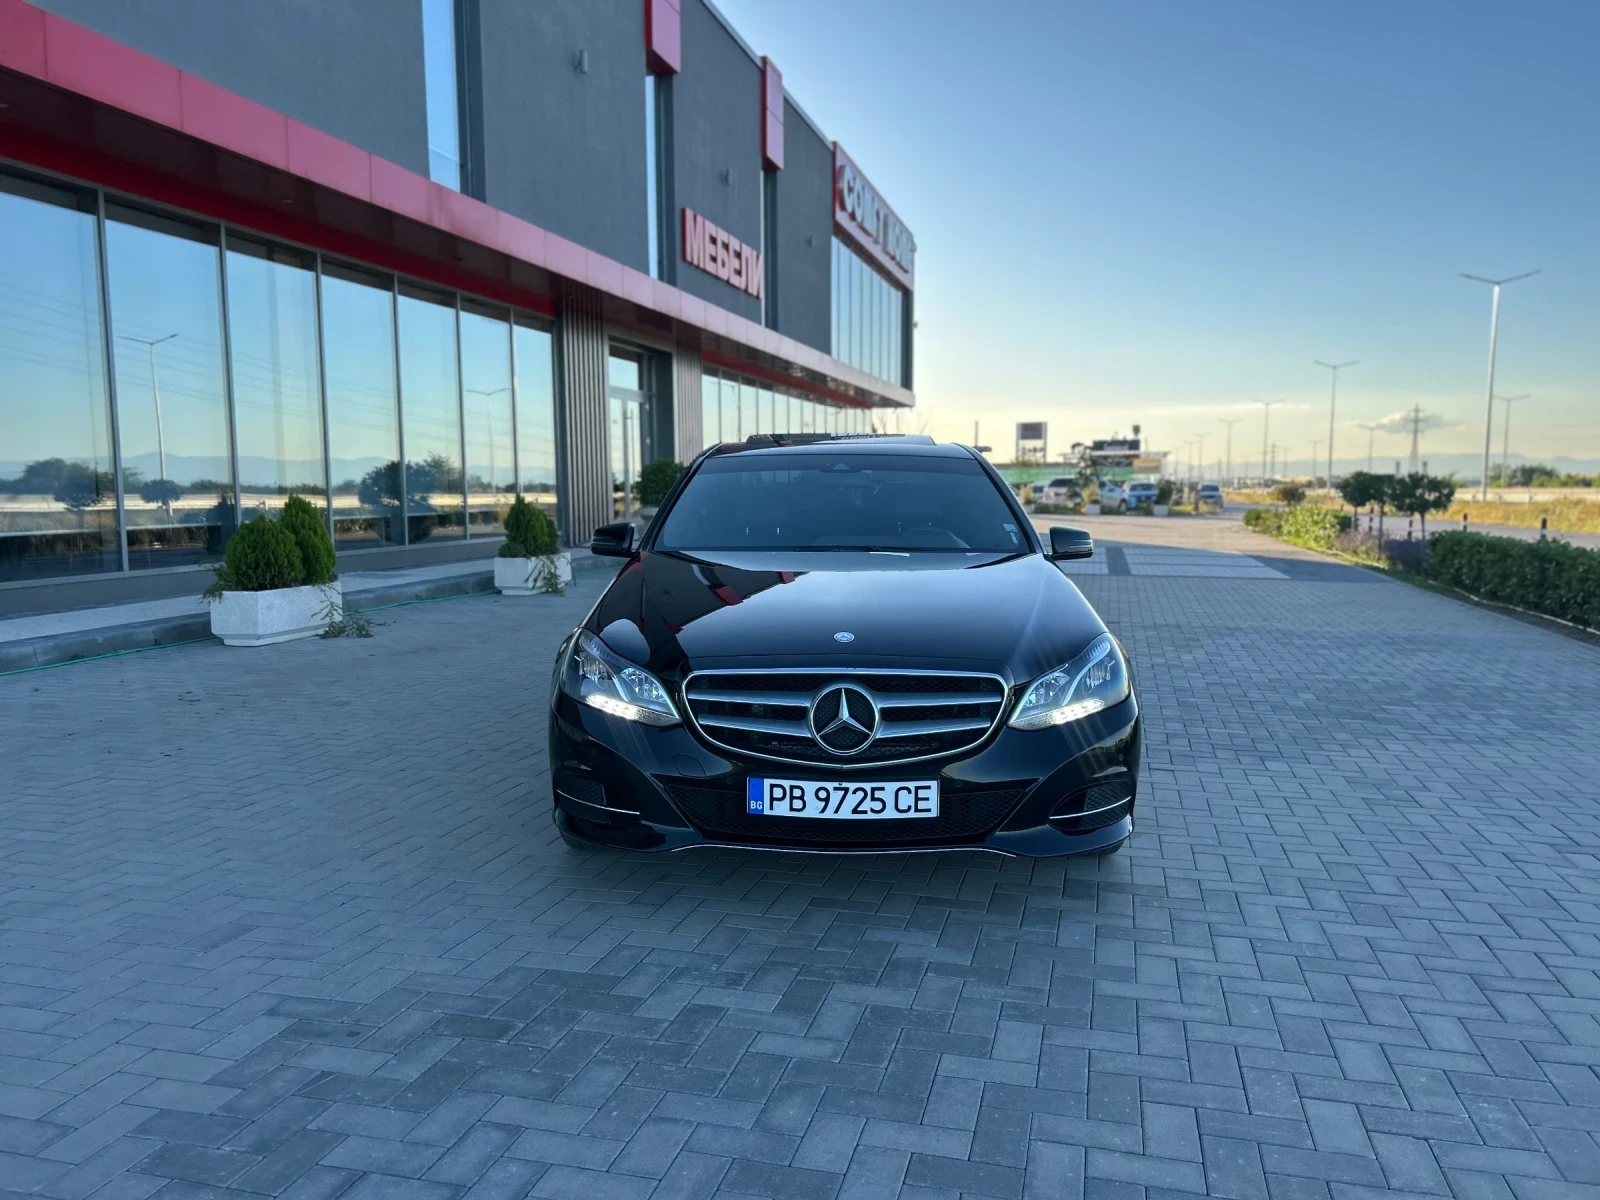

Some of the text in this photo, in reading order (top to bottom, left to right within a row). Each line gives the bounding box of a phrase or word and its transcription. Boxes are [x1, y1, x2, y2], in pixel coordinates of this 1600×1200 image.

[682, 208, 764, 298] МЕБЕЛИ
[750, 800, 763, 810] BG
[769, 784, 932, 815] PB 9725 CE
